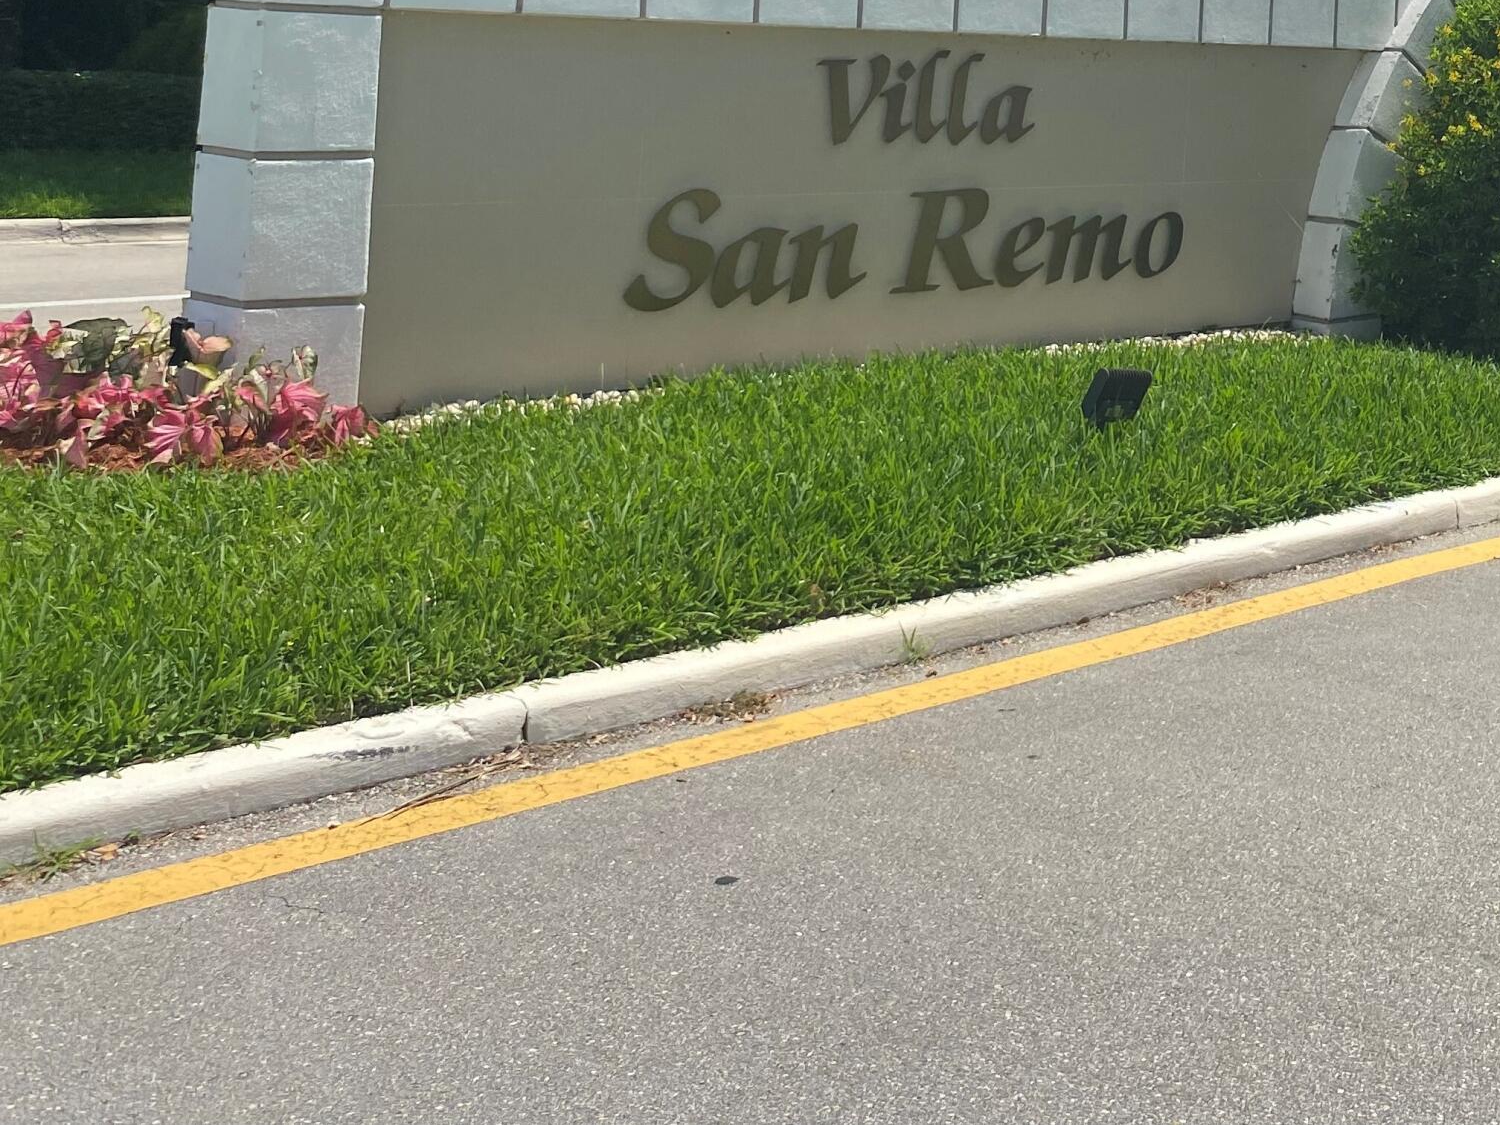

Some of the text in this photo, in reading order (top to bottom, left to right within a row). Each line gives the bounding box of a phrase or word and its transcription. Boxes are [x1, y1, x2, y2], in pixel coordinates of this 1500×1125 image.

[816, 50, 1035, 145] Villa
[623, 188, 1184, 312] San Remo
